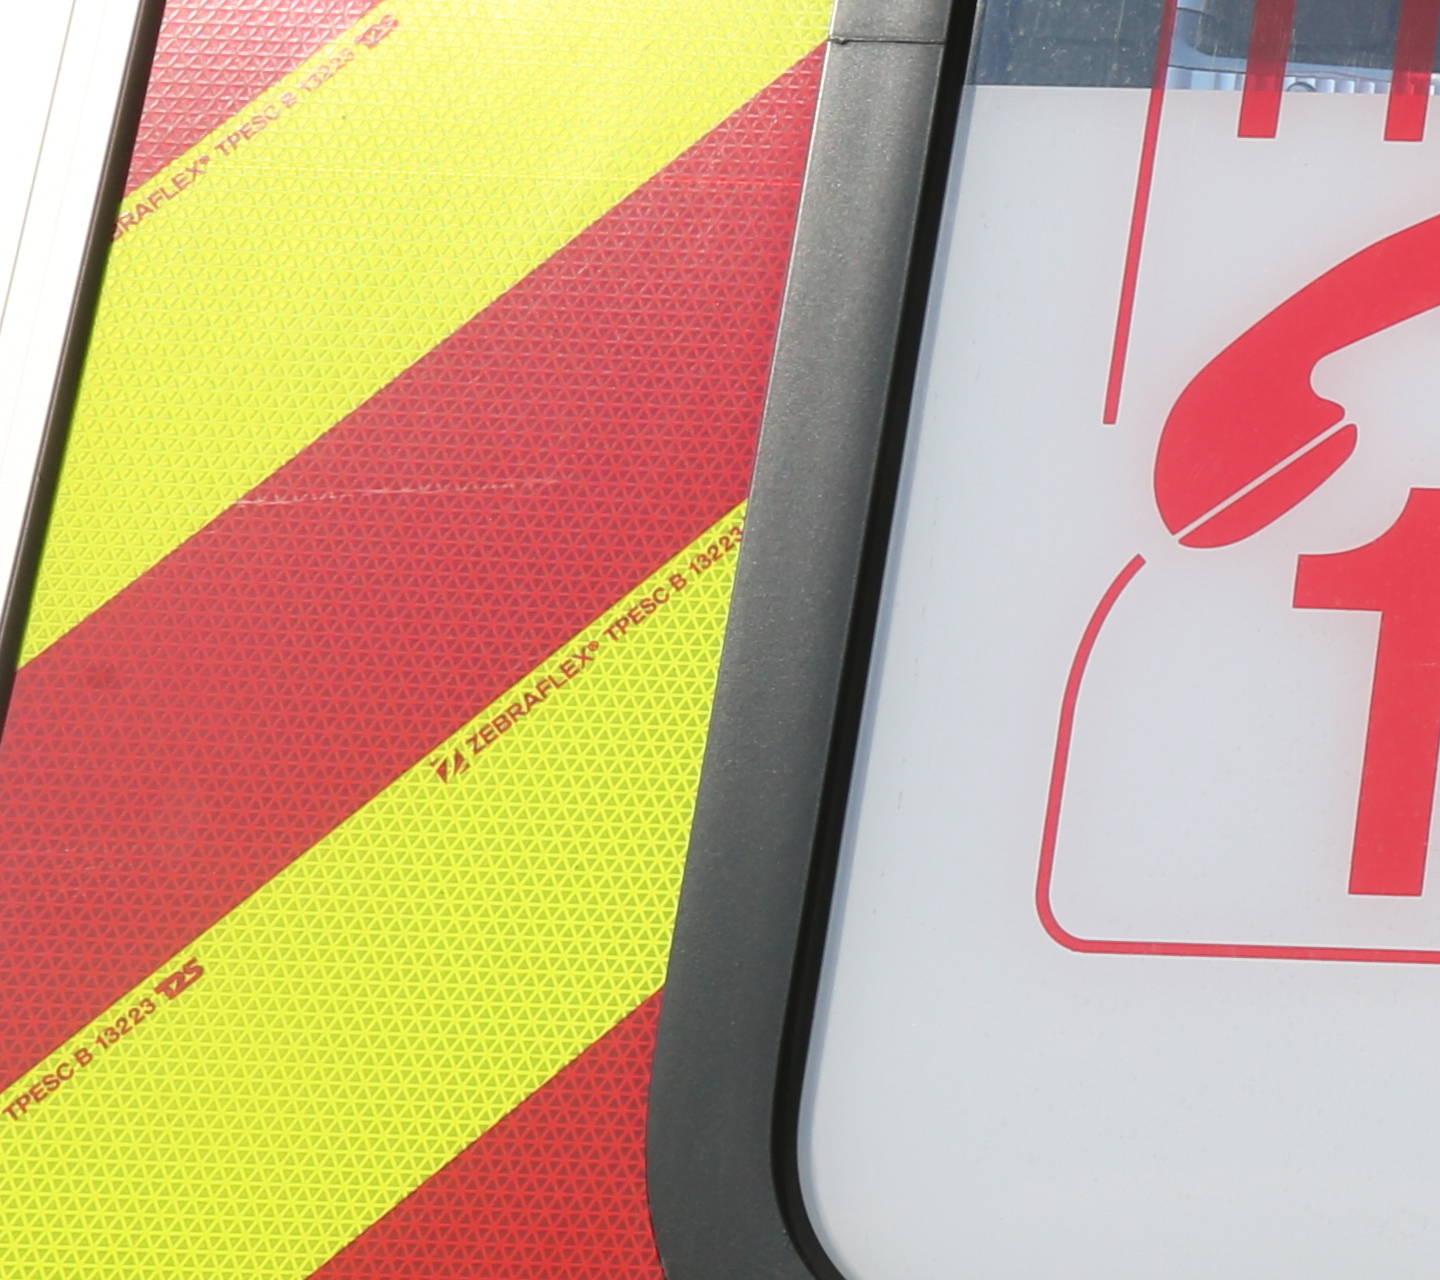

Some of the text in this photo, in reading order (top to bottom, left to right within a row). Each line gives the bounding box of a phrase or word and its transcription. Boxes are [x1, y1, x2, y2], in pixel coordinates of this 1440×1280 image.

[215, 100, 284, 158] TPESC
[603, 586, 670, 643] TPESC
[667, 572, 688, 591] B
[687, 524, 747, 575] 13223
[3, 1064, 75, 1119] TPESC
[73, 1047, 94, 1067] B
[93, 996, 158, 1050] 13223
